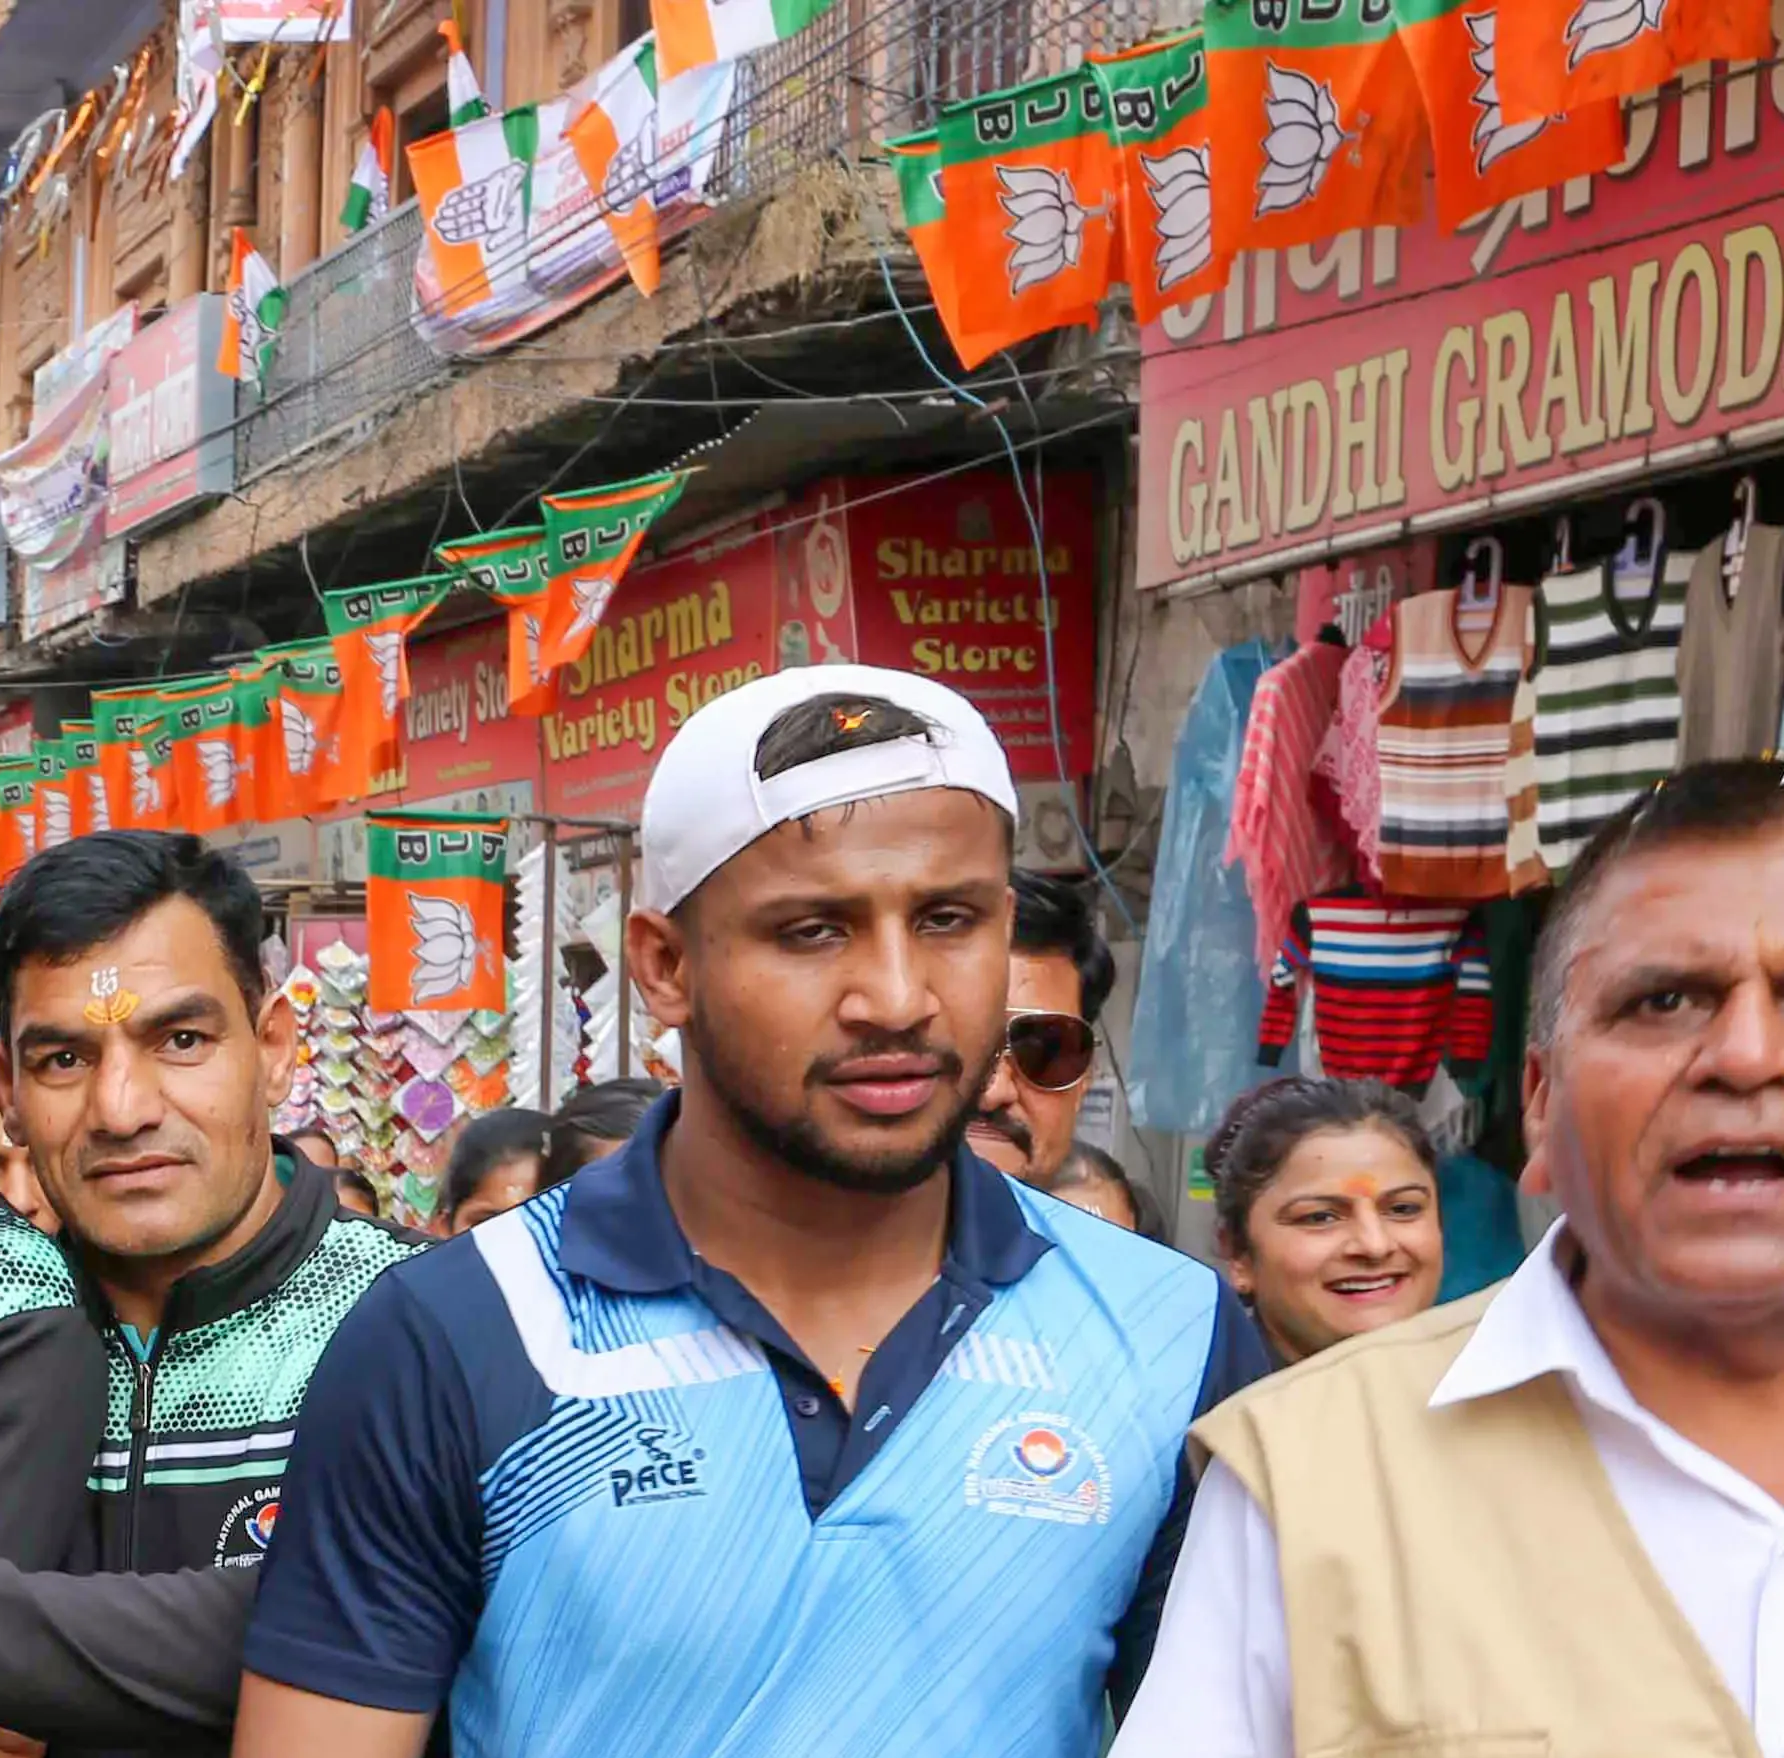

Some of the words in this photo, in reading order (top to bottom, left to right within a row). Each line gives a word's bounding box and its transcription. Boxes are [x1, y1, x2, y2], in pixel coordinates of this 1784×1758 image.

[1168, 349, 1409, 566] GANDHI
[1432, 224, 1784, 491] GRAMOD
[876, 537, 1070, 581] Sharma
[889, 586, 1060, 633] Variety
[911, 636, 1037, 675] Store
[405, 673, 470, 743] Variety
[542, 697, 656, 762] Variety
[610, 1460, 698, 1507] PACE
[216, 1495, 254, 1551] NATIONAL
